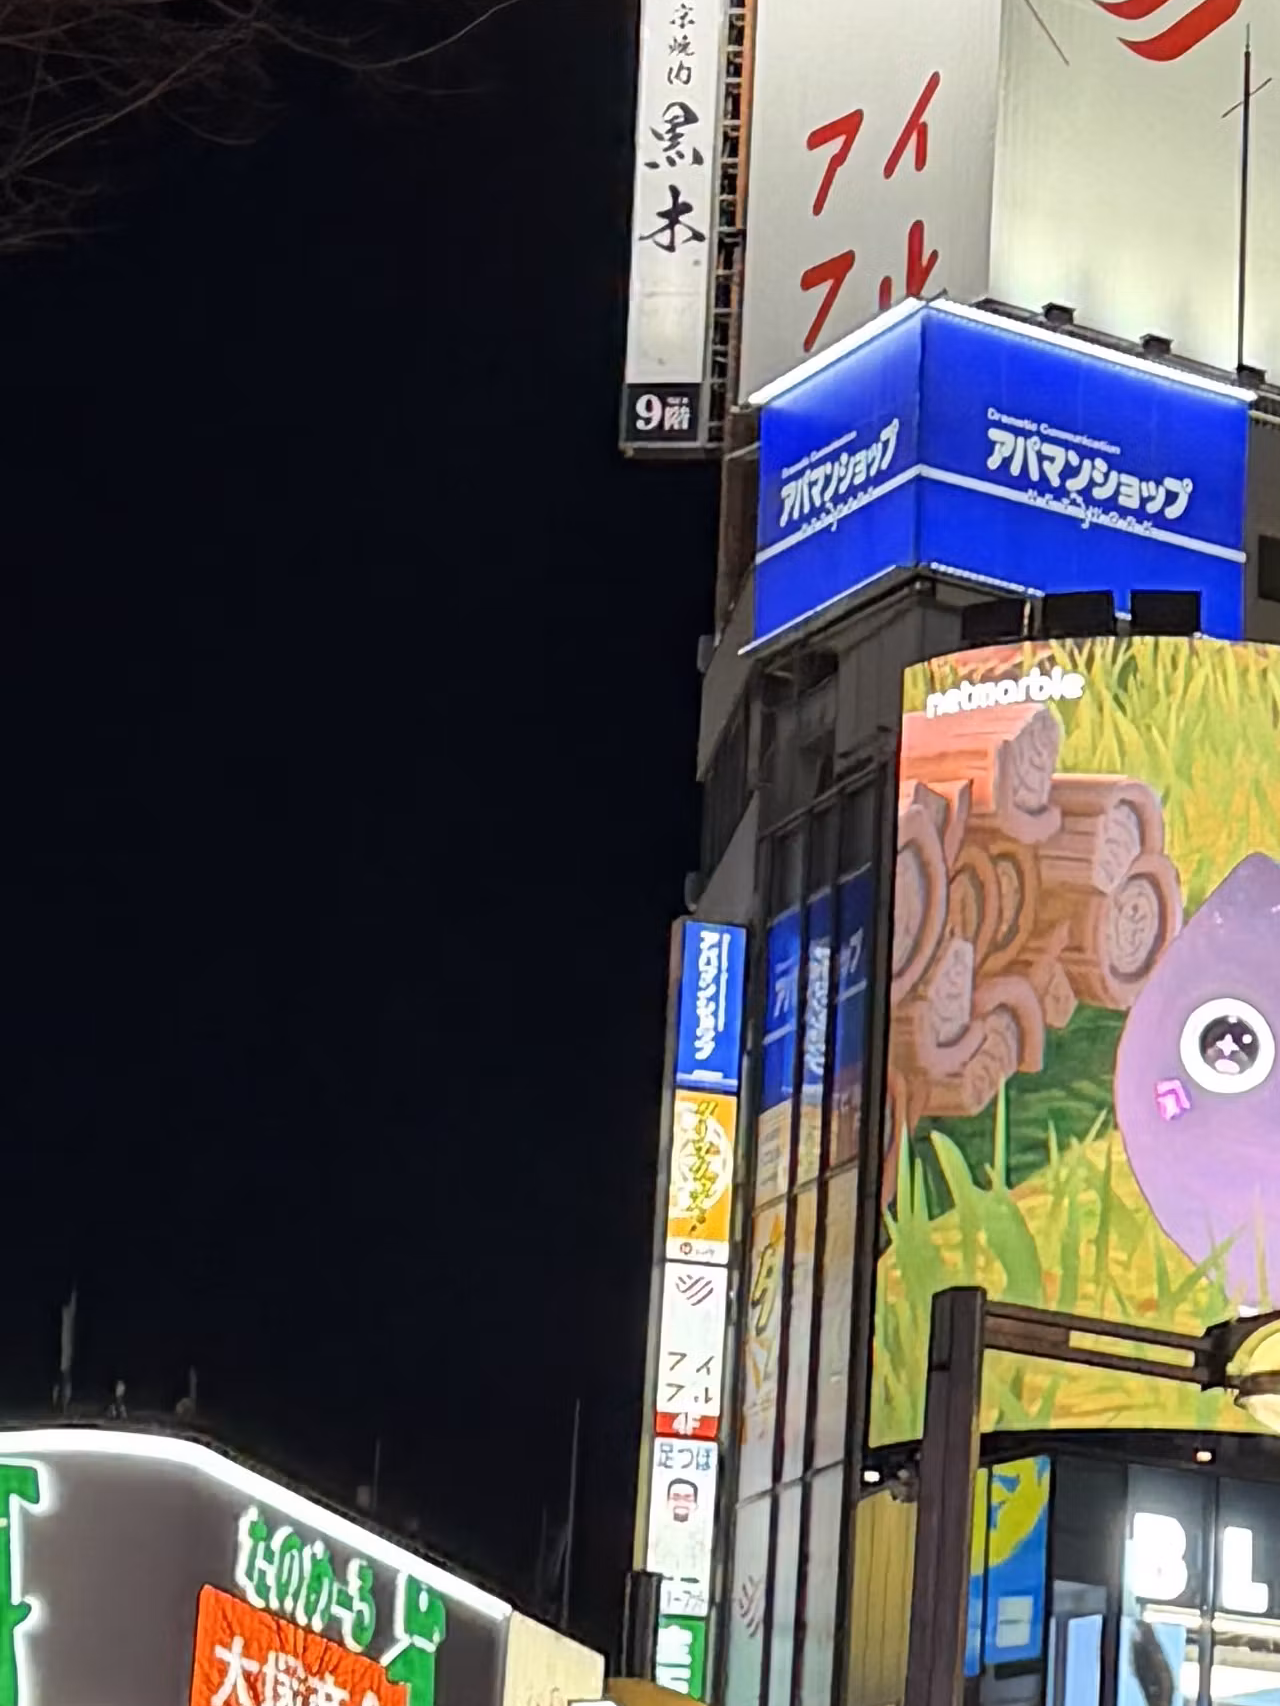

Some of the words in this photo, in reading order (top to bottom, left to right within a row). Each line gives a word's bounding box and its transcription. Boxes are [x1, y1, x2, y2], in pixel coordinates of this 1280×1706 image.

[986, 427, 1194, 520] アパマンショップ
[926, 667, 1085, 719] netmarble
